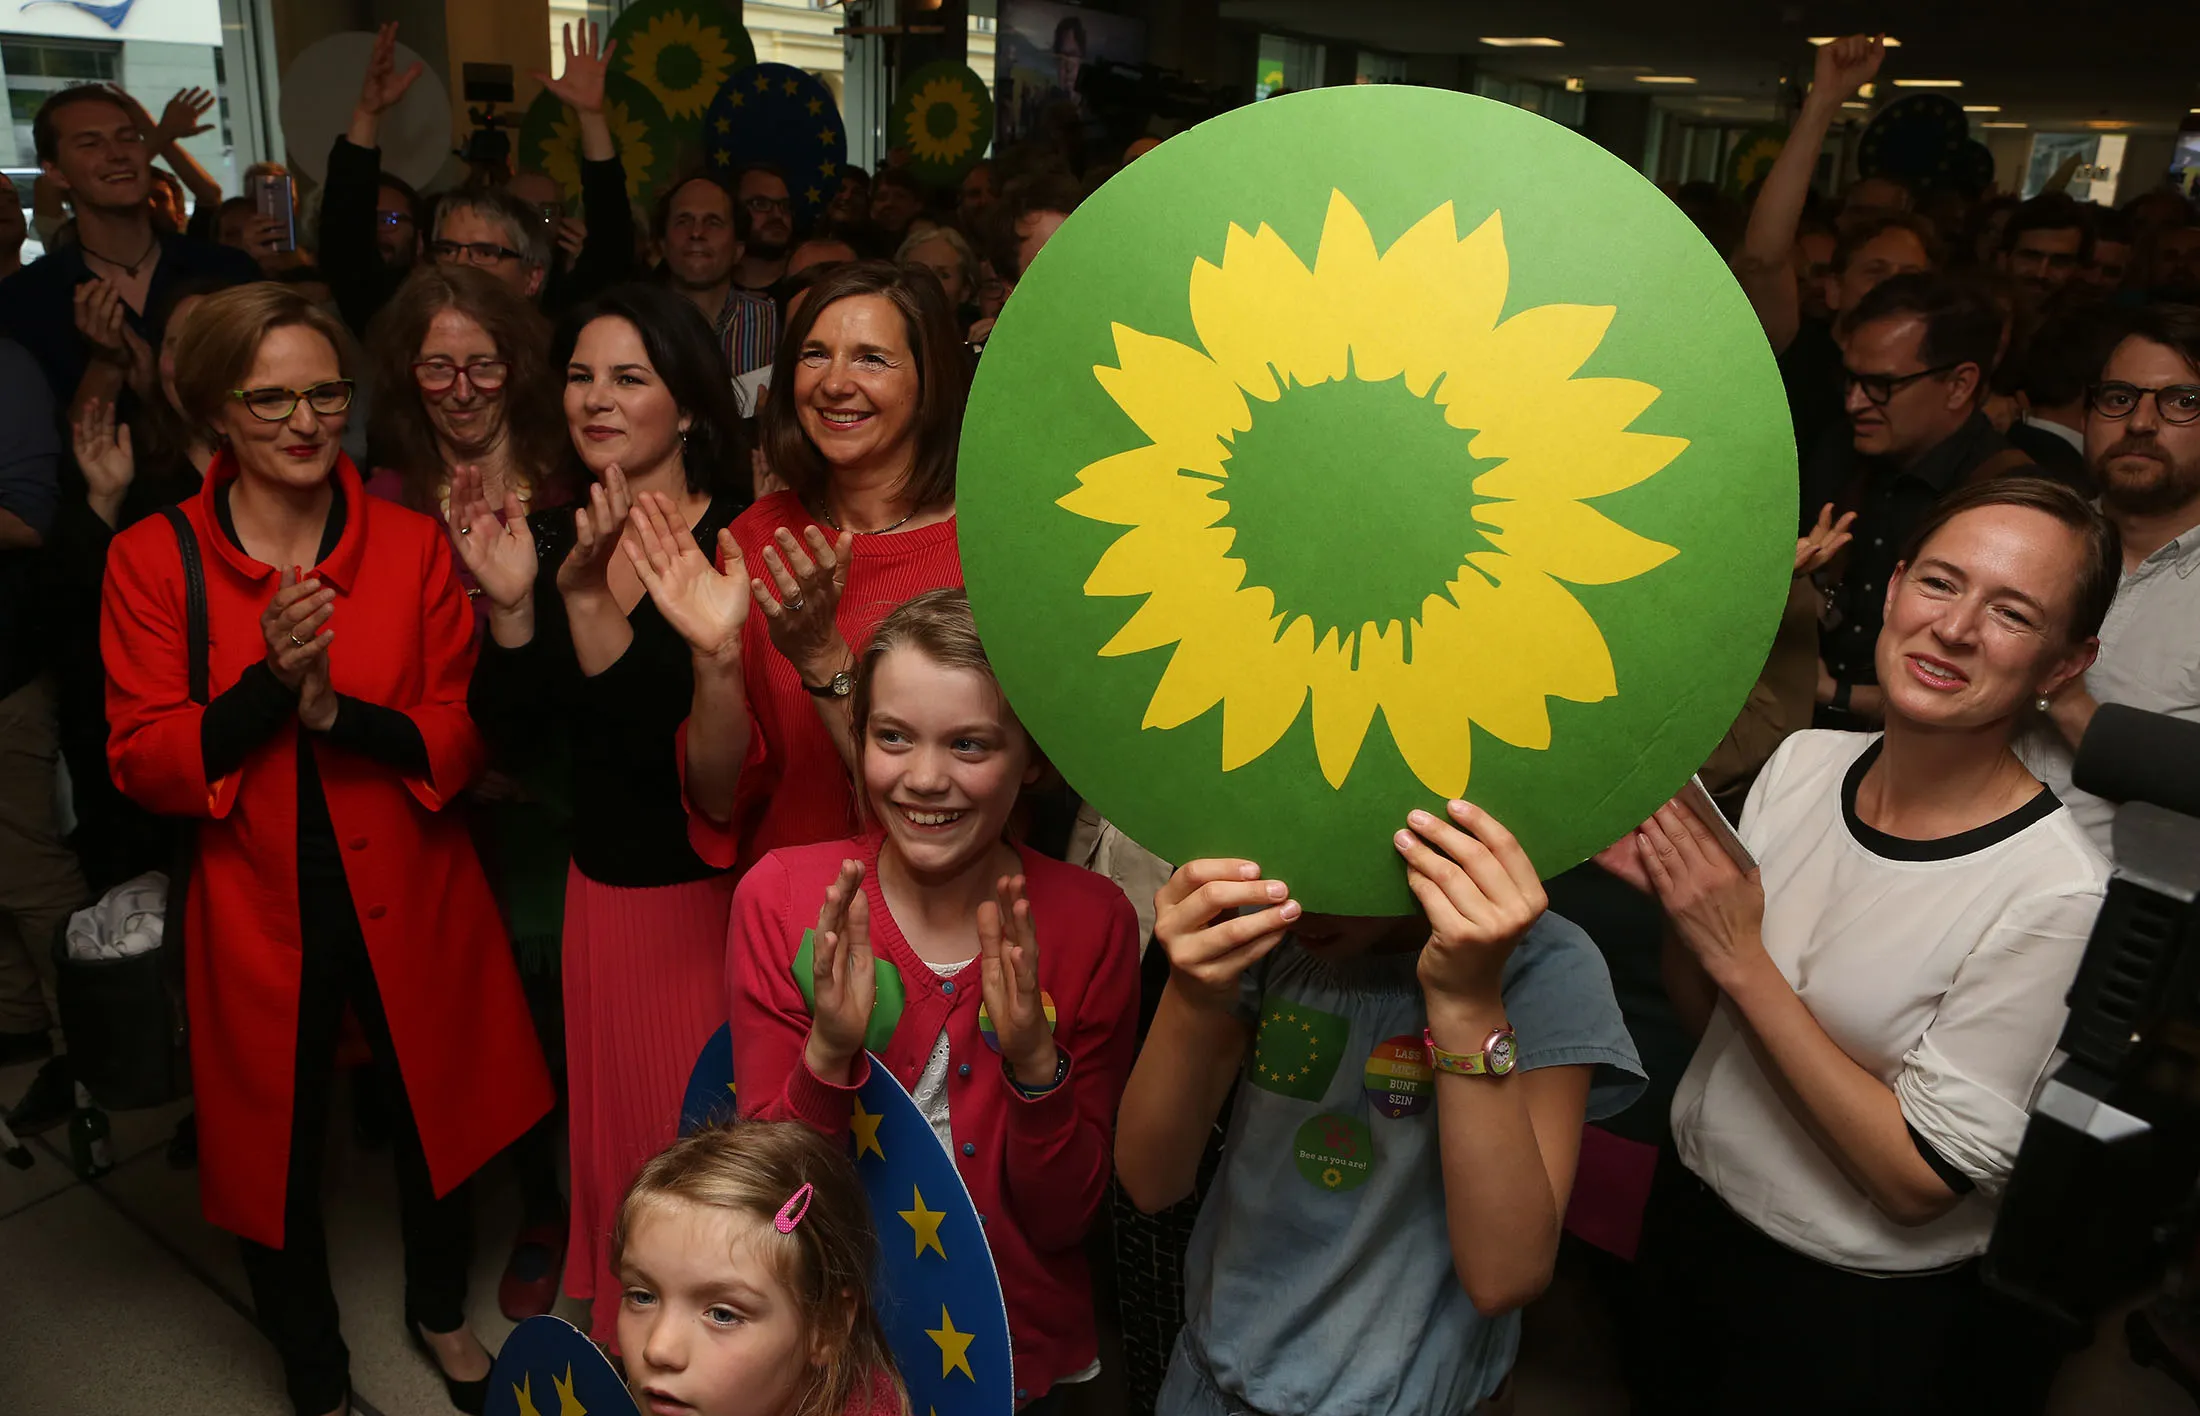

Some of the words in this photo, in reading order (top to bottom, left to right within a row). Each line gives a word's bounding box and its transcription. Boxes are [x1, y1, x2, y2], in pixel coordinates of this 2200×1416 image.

[1394, 1048, 1421, 1060] LASS
[1391, 1063, 1420, 1077] MICH
[1389, 1079, 1418, 1091] BUNT
[1389, 1093, 1413, 1106] SEIN
[1299, 1150, 1316, 1160] Bee
[1317, 1154, 1329, 1162] as
[1329, 1156, 1346, 1166] you
[1347, 1160, 1367, 1170] are!
